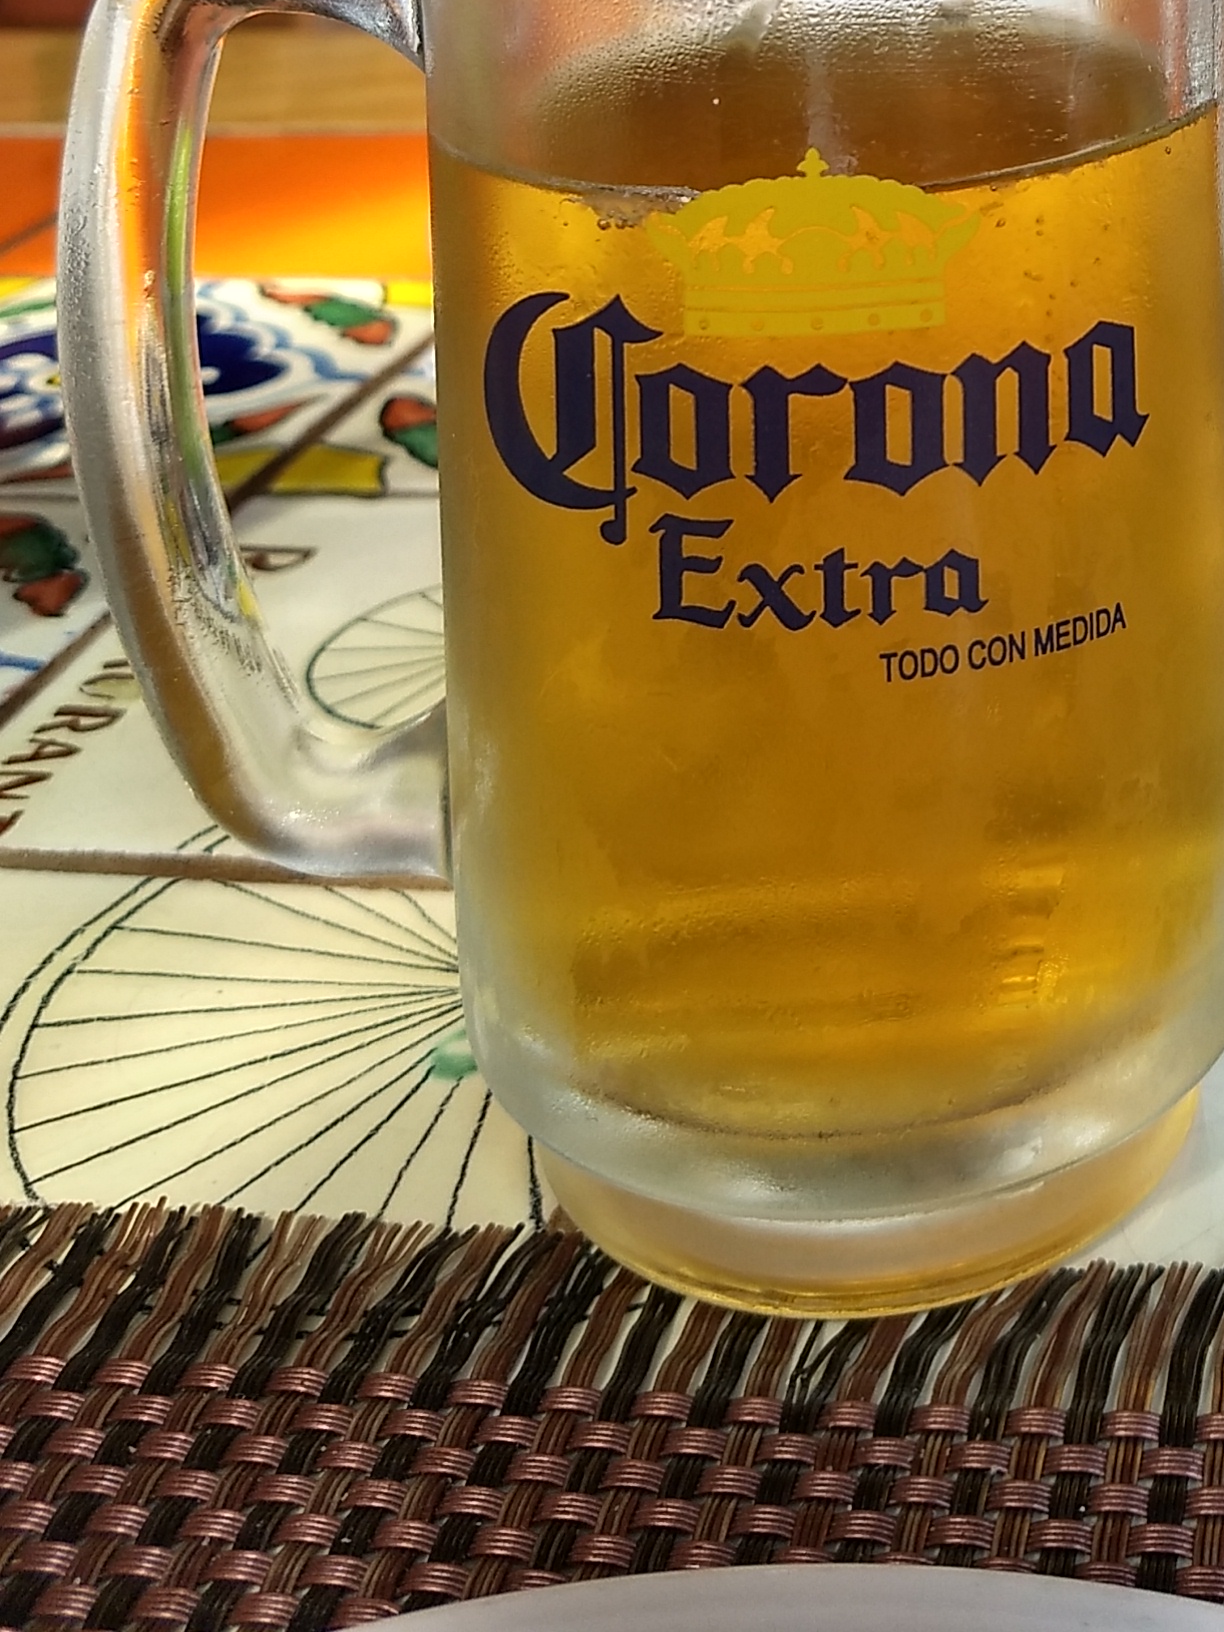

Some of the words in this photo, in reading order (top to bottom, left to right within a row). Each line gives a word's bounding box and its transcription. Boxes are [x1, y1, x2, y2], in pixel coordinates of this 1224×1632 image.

[484, 291, 1150, 545] Corona
[649, 512, 989, 630] Extra
[879, 643, 960, 683] TODO
[967, 630, 1026, 670] CON
[1033, 602, 1127, 657] MEDIDA
